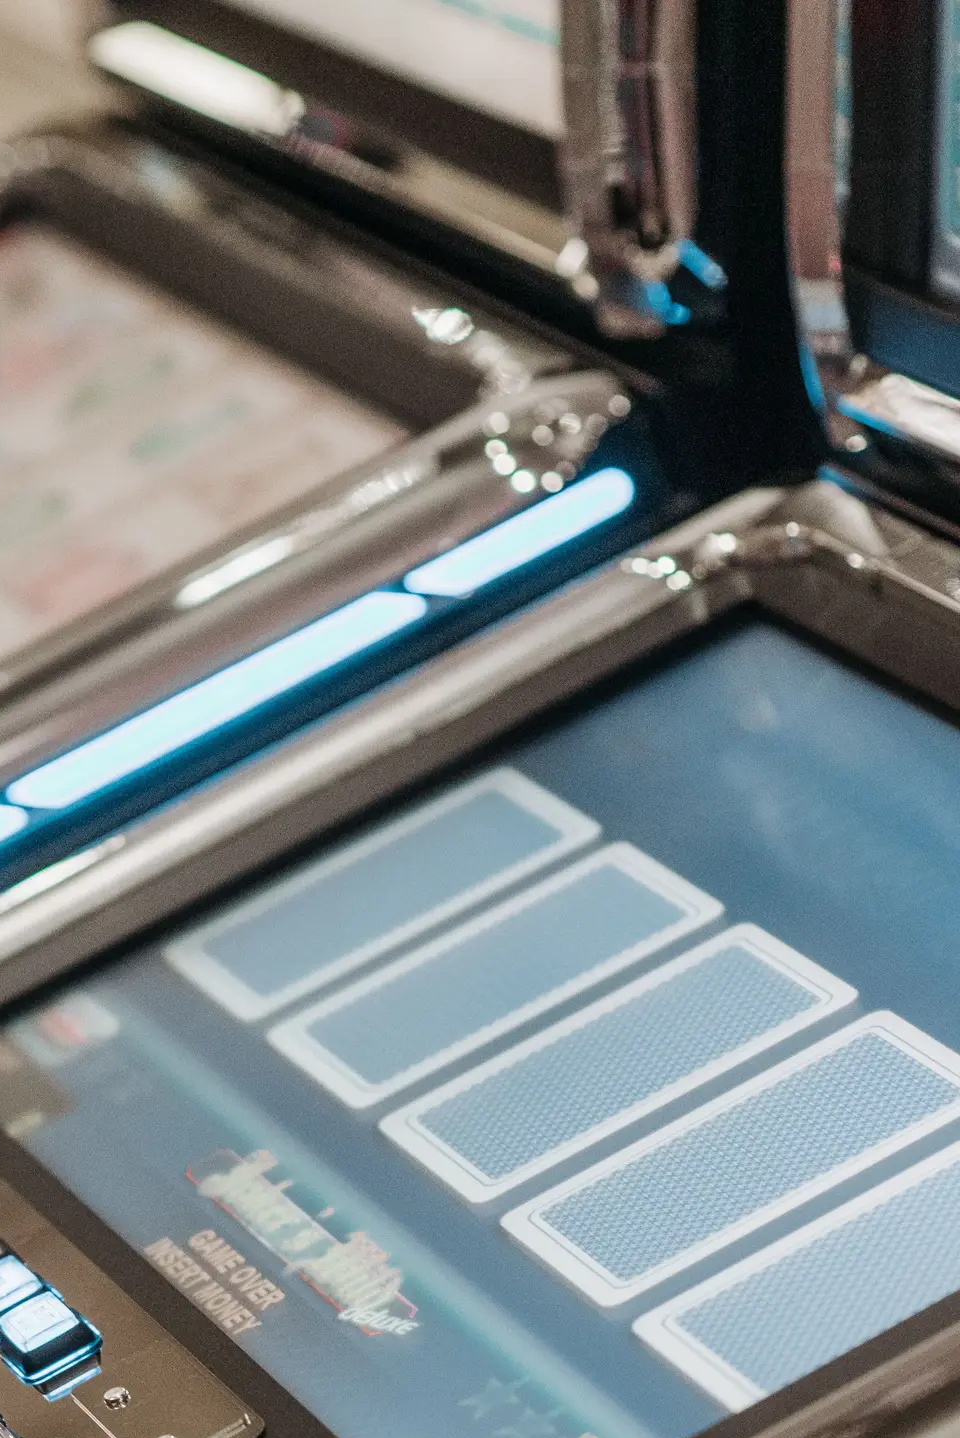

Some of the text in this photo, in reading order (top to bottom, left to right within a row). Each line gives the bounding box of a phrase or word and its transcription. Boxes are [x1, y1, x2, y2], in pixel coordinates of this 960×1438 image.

[142, 1237, 263, 1335] INSERT MONEY
[189, 1230, 246, 1274] GAME
[229, 1266, 286, 1311] OVER
